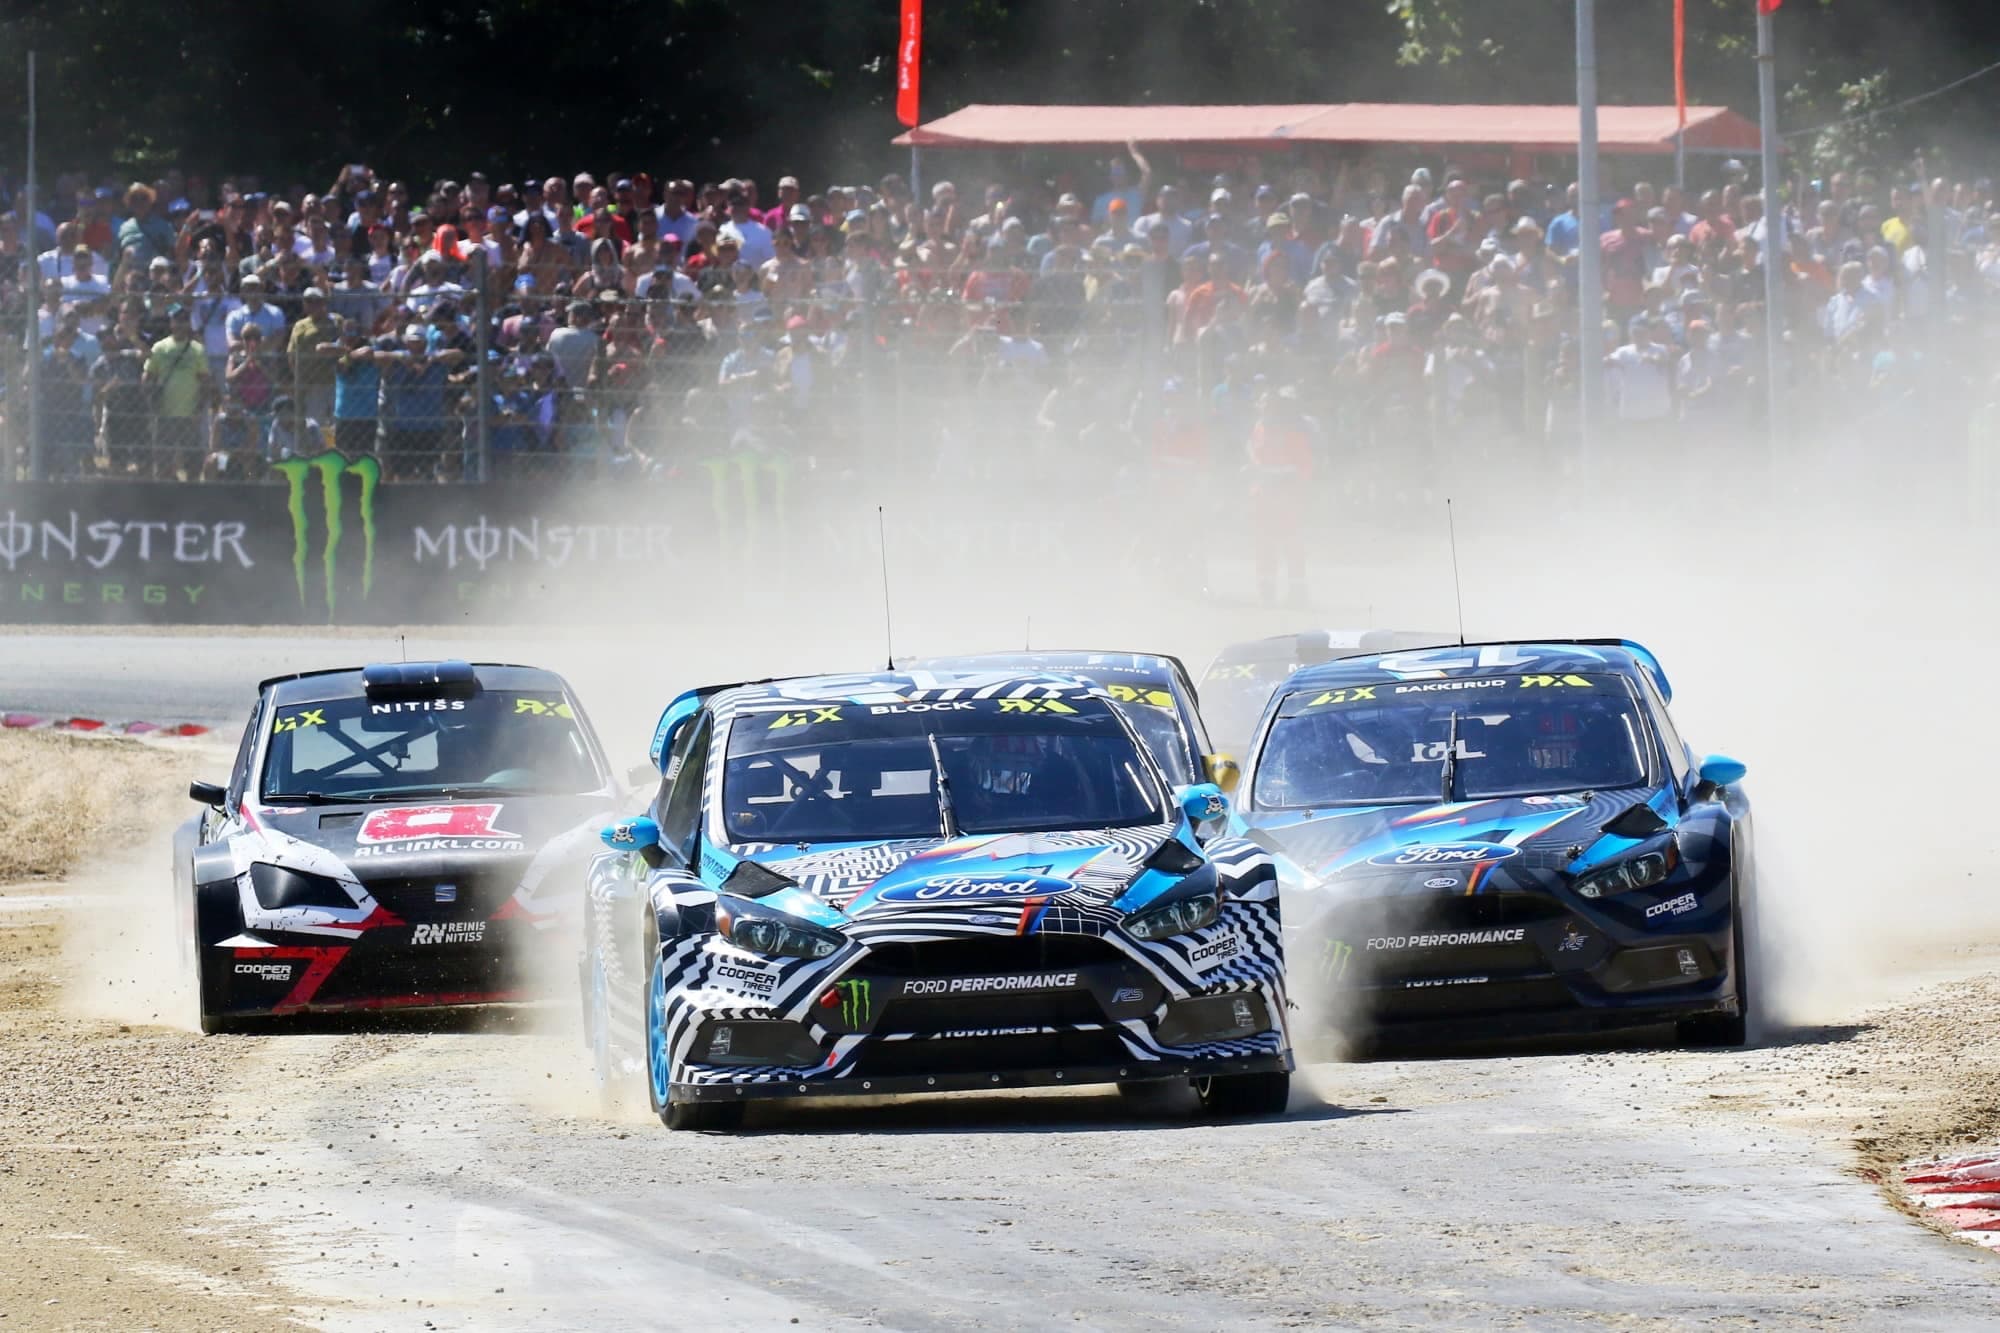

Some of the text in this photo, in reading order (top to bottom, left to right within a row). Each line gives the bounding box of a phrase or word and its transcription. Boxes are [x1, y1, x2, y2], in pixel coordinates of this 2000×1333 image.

[0, 509, 255, 571] ONSTER
[21, 582, 205, 604] NERGY
[1395, 679, 1506, 694] BAKKERUD
[371, 699, 466, 715] NITIŠS
[870, 700, 977, 715] BLOCK
[1395, 843, 1488, 864] Ford
[914, 874, 1038, 899] Ford
[1645, 892, 1695, 918] COOPER
[1671, 902, 1698, 916] TIRES
[411, 923, 447, 945] RN
[449, 921, 485, 932] REINIS
[445, 931, 482, 943] NITISS
[1367, 929, 1525, 950] FORD PERFORMANCE
[1192, 937, 1236, 962] COOPER
[1217, 947, 1239, 961] TIRES
[234, 964, 292, 974] COOPER
[261, 972, 290, 981] TIRES
[717, 966, 777, 985] COOPER
[743, 981, 774, 993] TIRES
[903, 973, 1078, 994] FORD PERFORMANCE
